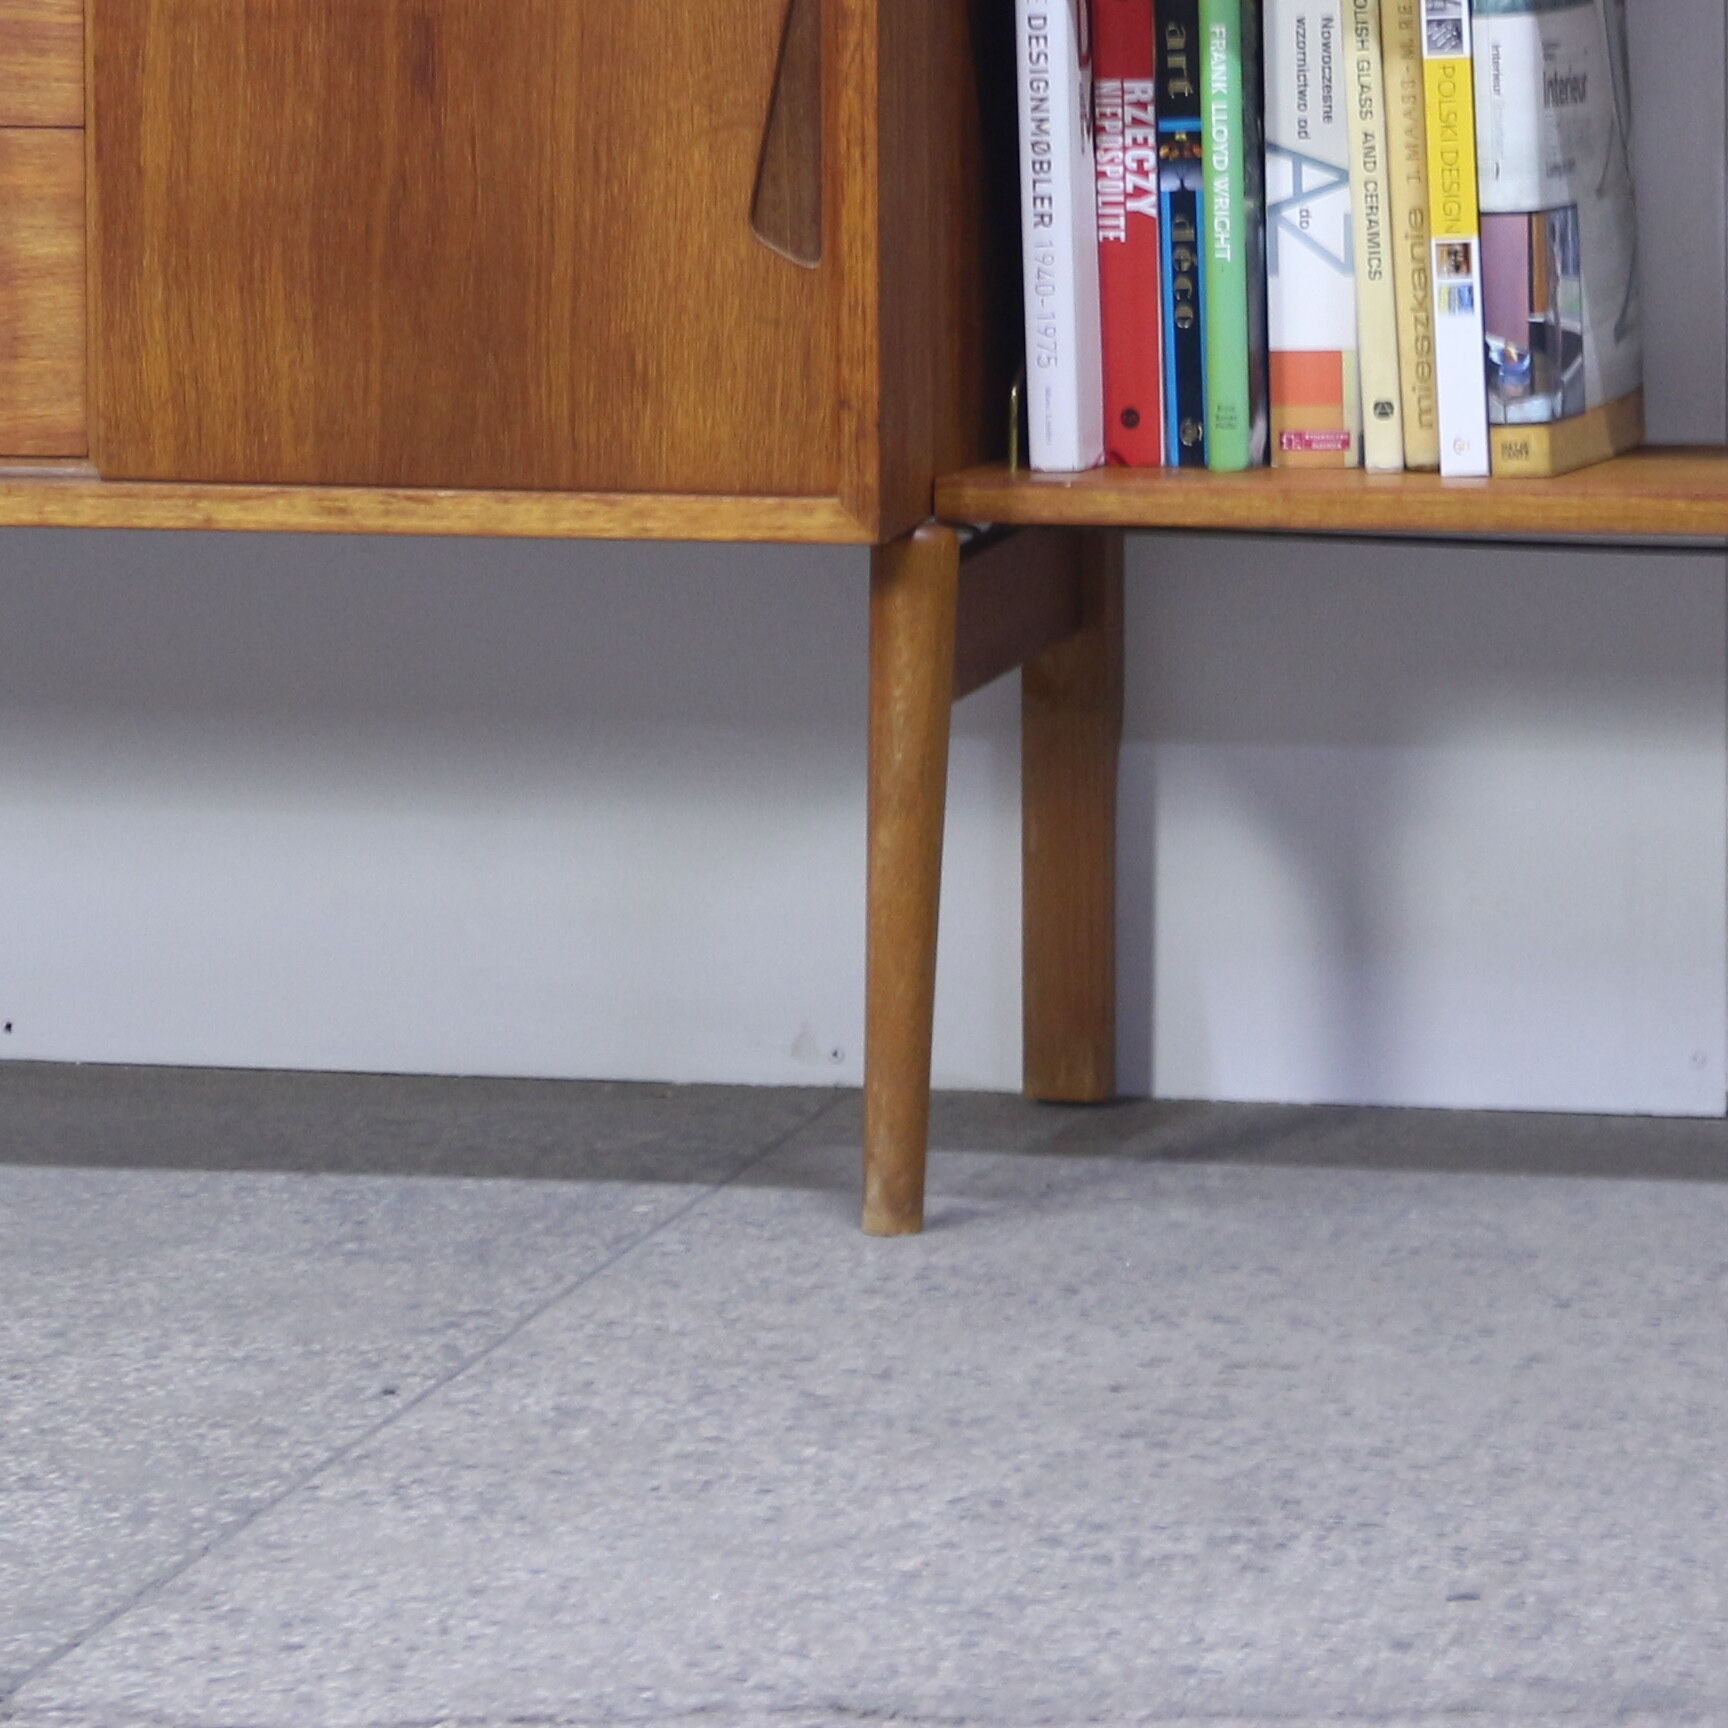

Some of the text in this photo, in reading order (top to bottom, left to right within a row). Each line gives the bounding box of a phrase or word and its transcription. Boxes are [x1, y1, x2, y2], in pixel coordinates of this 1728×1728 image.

[1165, 23, 1193, 100] art
[1296, 15, 1309, 113] wzornictwo
[1321, 16, 1335, 124] Nowoczesne
[1357, 59, 1374, 122] GLASS
[1027, 15, 1053, 230] DESIGNMØBLER
[1094, 79, 1127, 243] NIEPOSPOLITE
[1123, 79, 1158, 219] RZECZY
[1209, 23, 1232, 263] FRANK LLOYD WRIGHT
[1266, 142, 1350, 209] A
[1297, 118, 1310, 140] od
[1361, 131, 1377, 173] AND
[1437, 63, 1462, 235] POLSKI DESIGN
[1172, 214, 1198, 329] deco
[1299, 208, 1312, 230] do
[1363, 179, 1383, 281] CERAMICS
[1033, 240, 1059, 370] 1940-1975
[1404, 206, 1434, 430] mieszkanie
